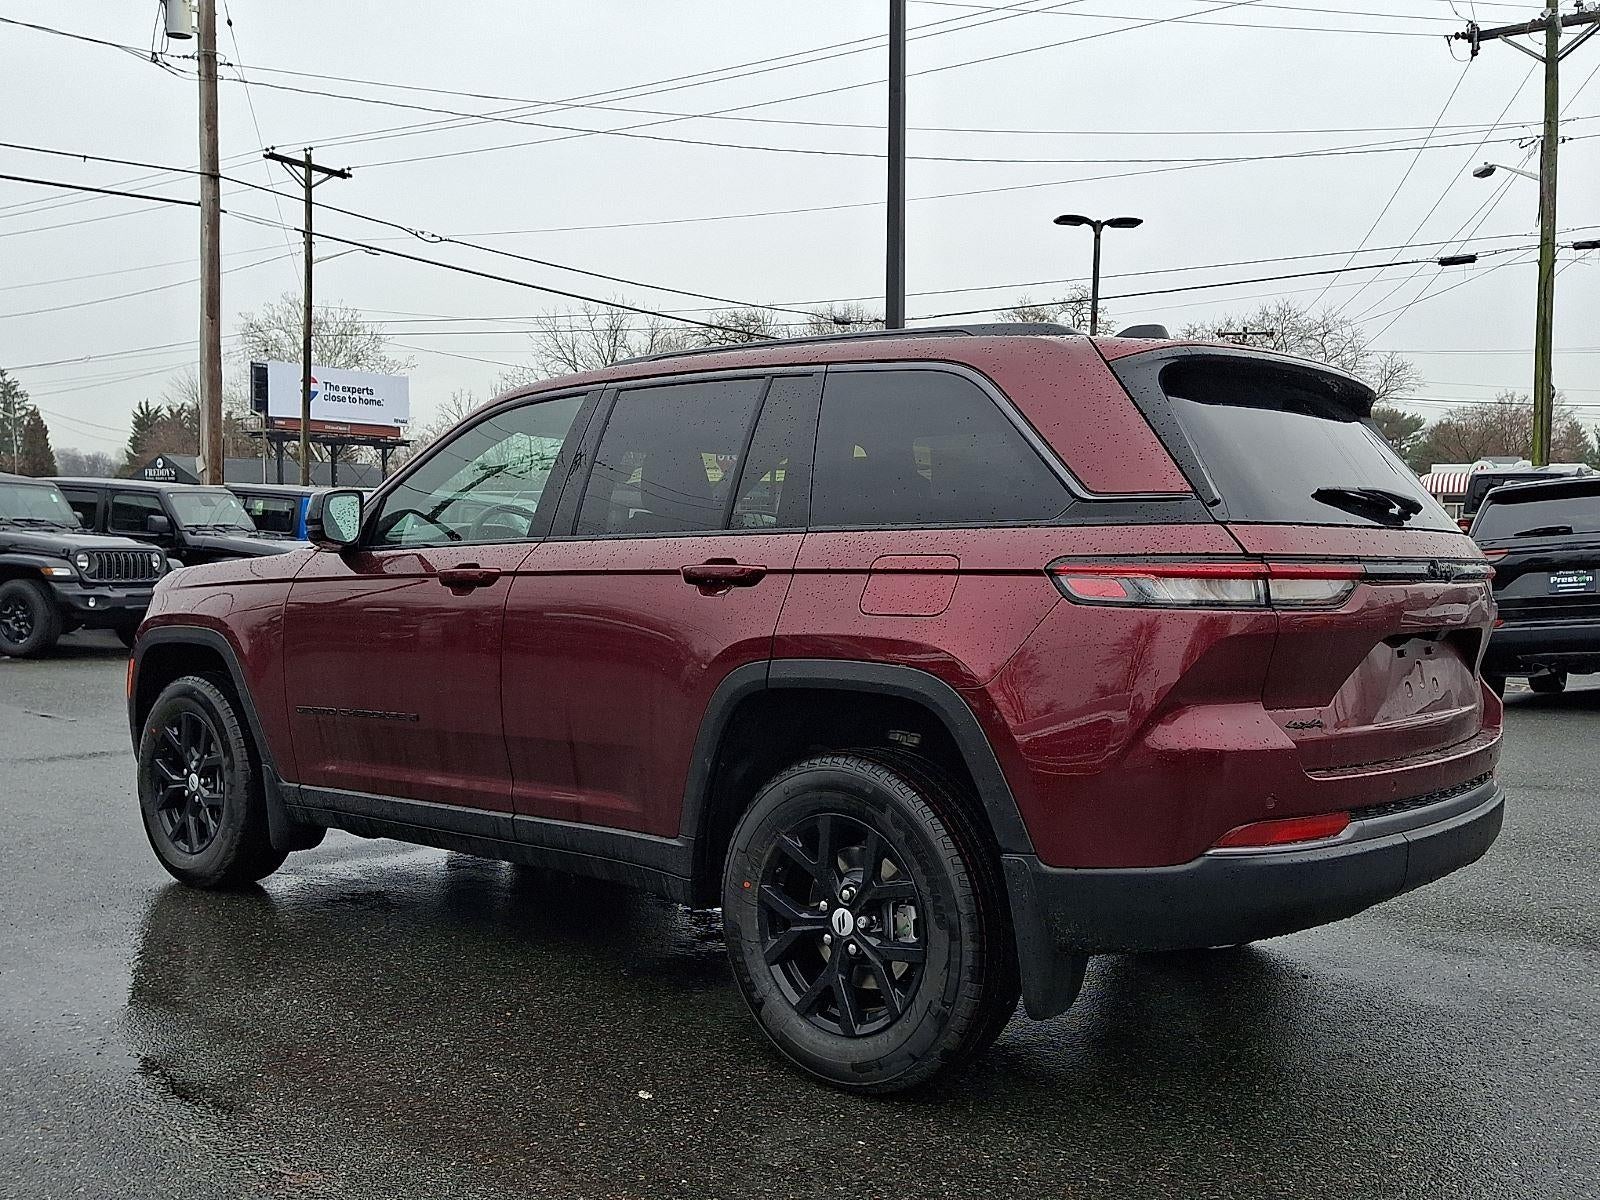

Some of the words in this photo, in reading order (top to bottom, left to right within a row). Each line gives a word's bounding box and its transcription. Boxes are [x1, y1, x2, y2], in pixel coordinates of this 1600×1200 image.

[323, 381, 340, 392] The
[341, 385, 374, 396] experts
[323, 392, 347, 403] close
[348, 395, 358, 404] to
[1550, 575, 1593, 584] Preston
